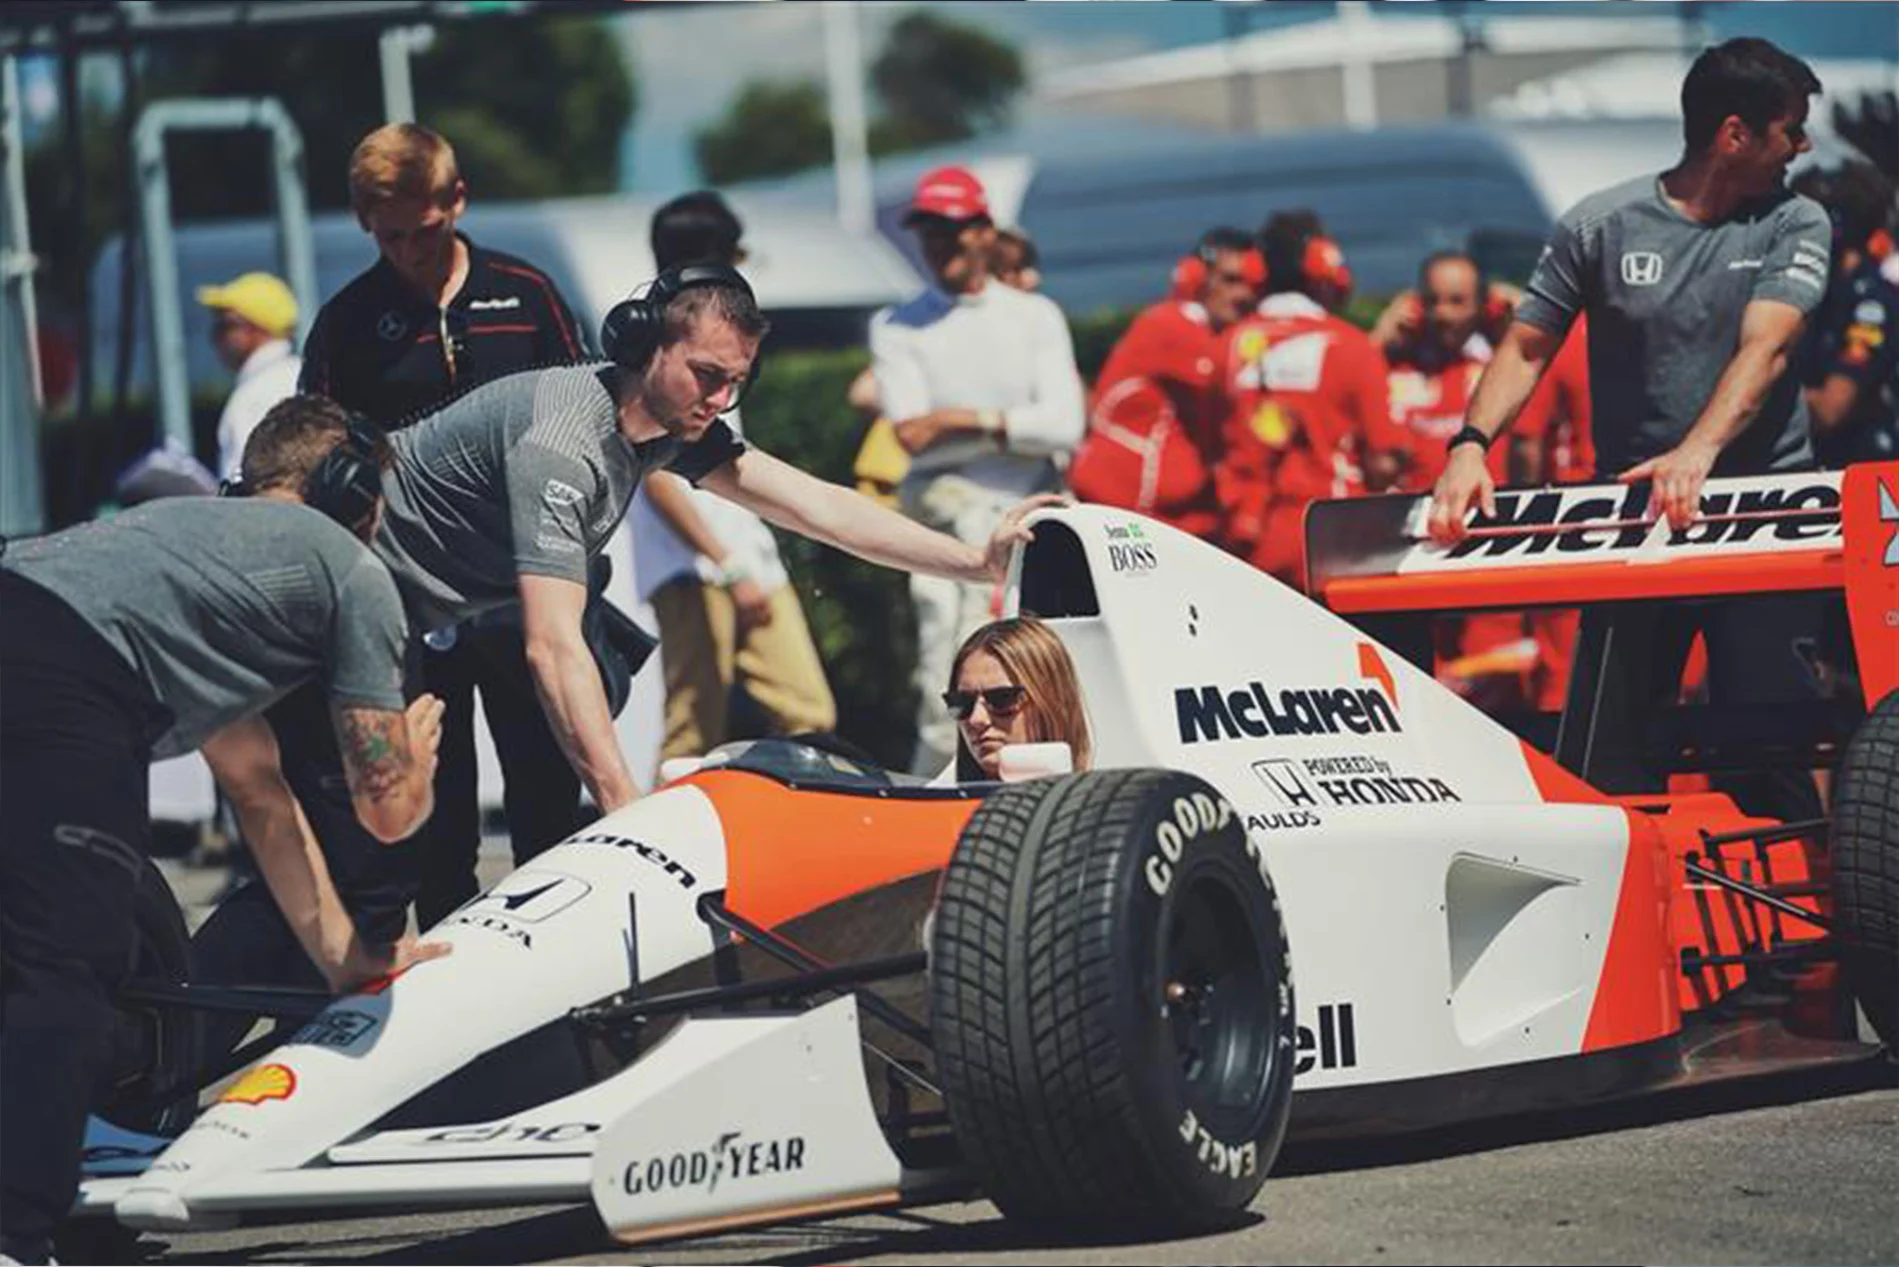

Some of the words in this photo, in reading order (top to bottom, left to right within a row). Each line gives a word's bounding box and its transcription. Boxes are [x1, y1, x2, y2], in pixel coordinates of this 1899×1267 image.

[1442, 481, 1843, 559] McLare
[1107, 543, 1157, 572] BOSS
[1174, 682, 1402, 744] McLaren
[1247, 811, 1322, 831] AULDS
[1317, 777, 1461, 806] HONDA
[1295, 1003, 1356, 1076] ell
[1179, 1109, 1257, 1179] EAGLE
